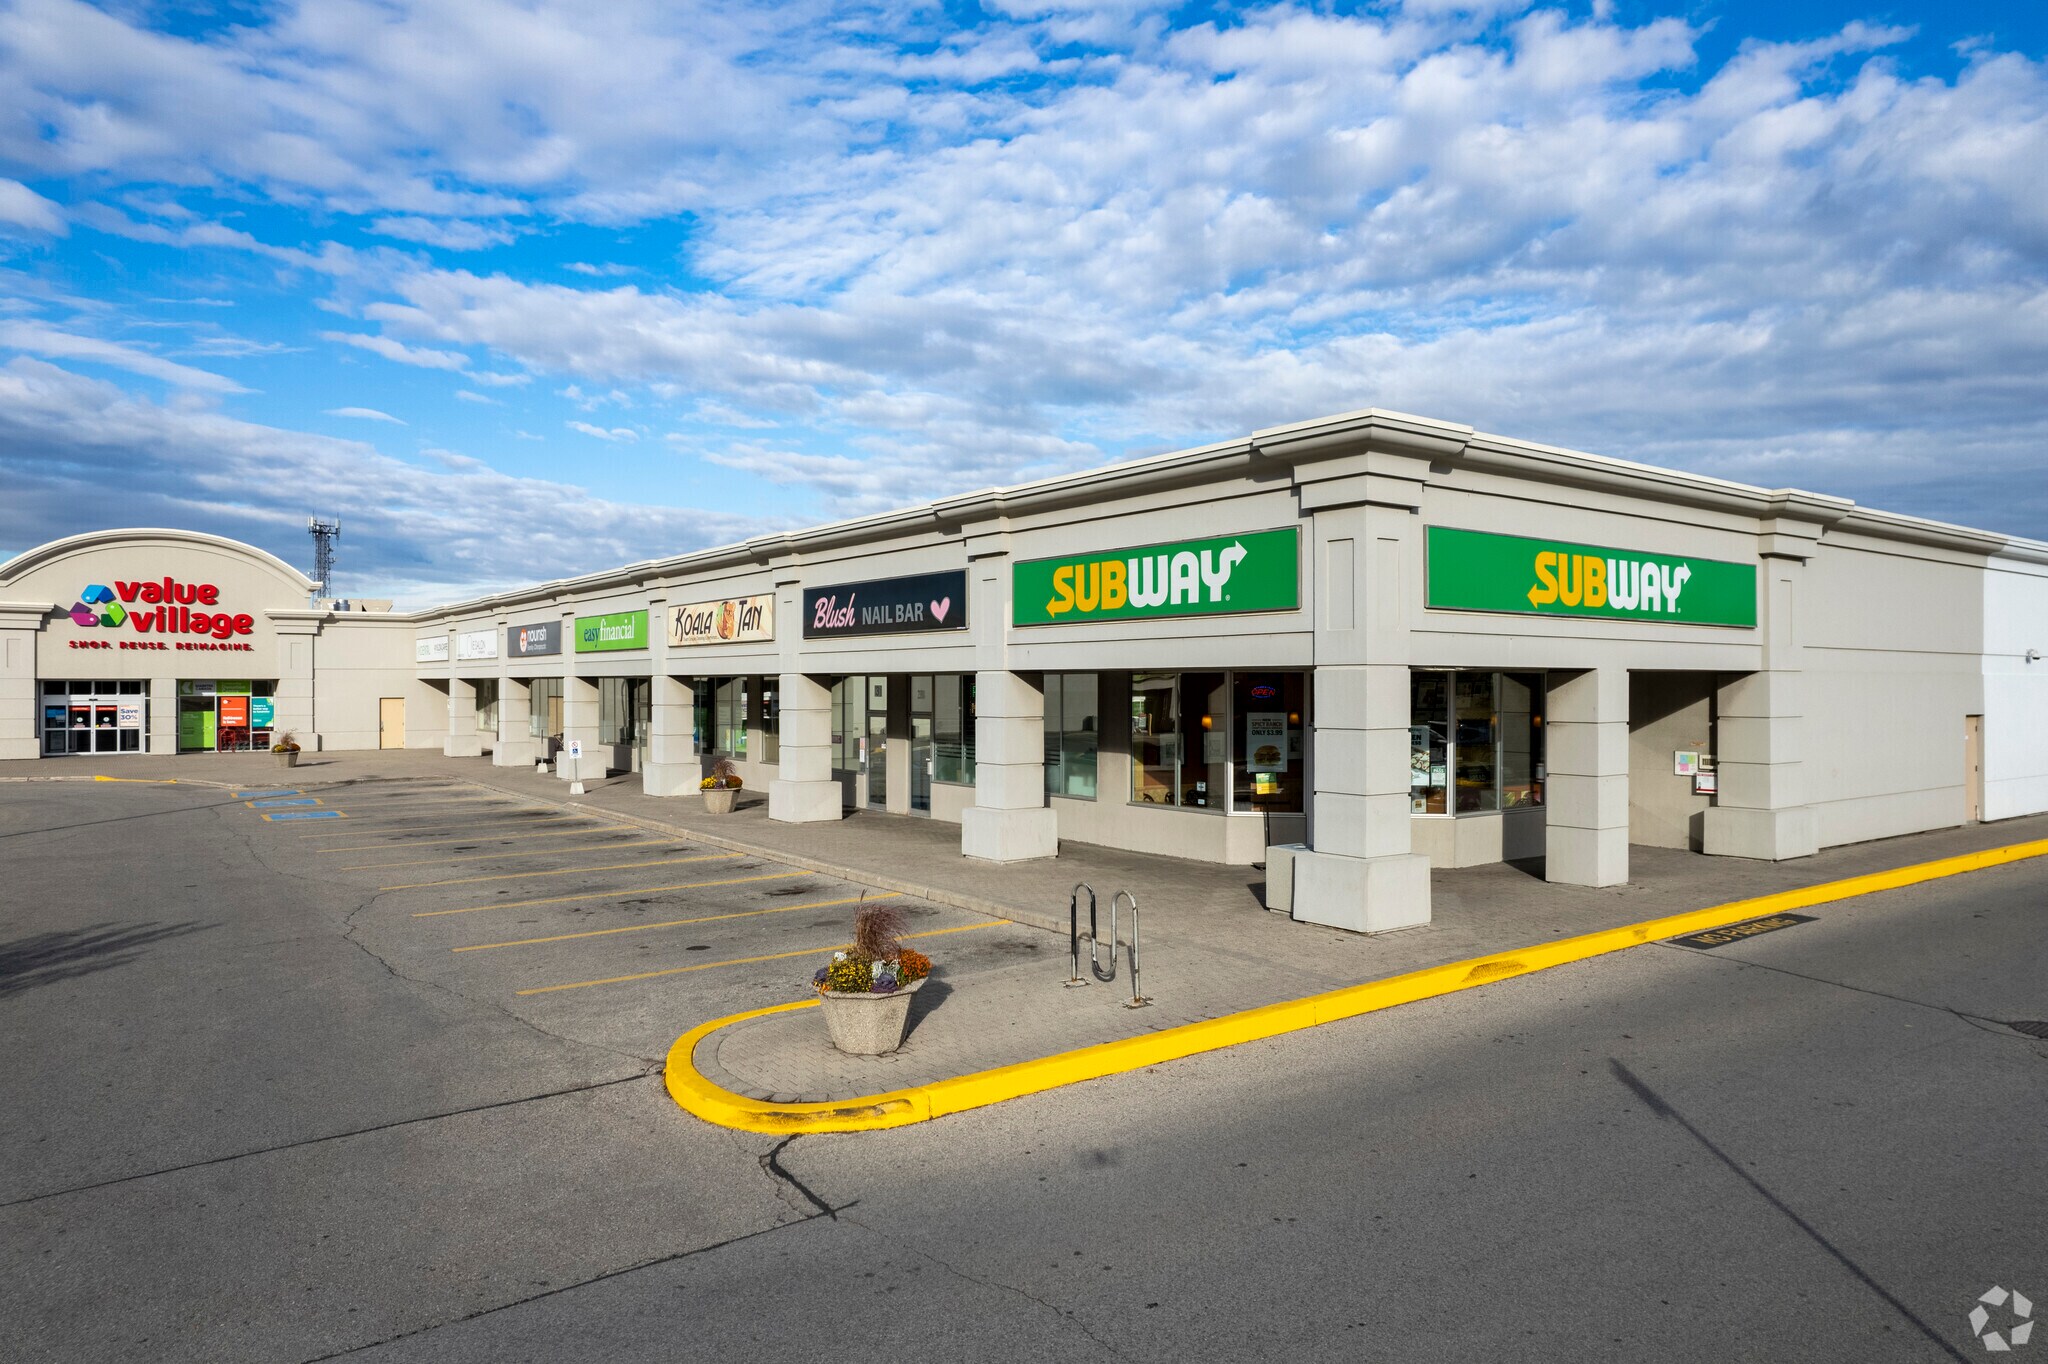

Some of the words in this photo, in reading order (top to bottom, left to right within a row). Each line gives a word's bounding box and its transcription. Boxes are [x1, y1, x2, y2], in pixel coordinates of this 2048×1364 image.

[115, 577, 219, 605] value
[1046, 540, 1248, 619] SUBWAY
[1527, 551, 1691, 613] SUBWAY
[129, 606, 254, 639] village
[675, 607, 714, 642] KOALA
[737, 600, 763, 637] TAN
[813, 592, 856, 630] Blush
[862, 605, 893, 626] NAIL
[895, 602, 924, 624] BAR
[527, 625, 547, 642] nourish
[1251, 688, 1276, 696] OPEN
[1690, 932, 1732, 945] NO
[1717, 917, 1798, 938] PARKING
